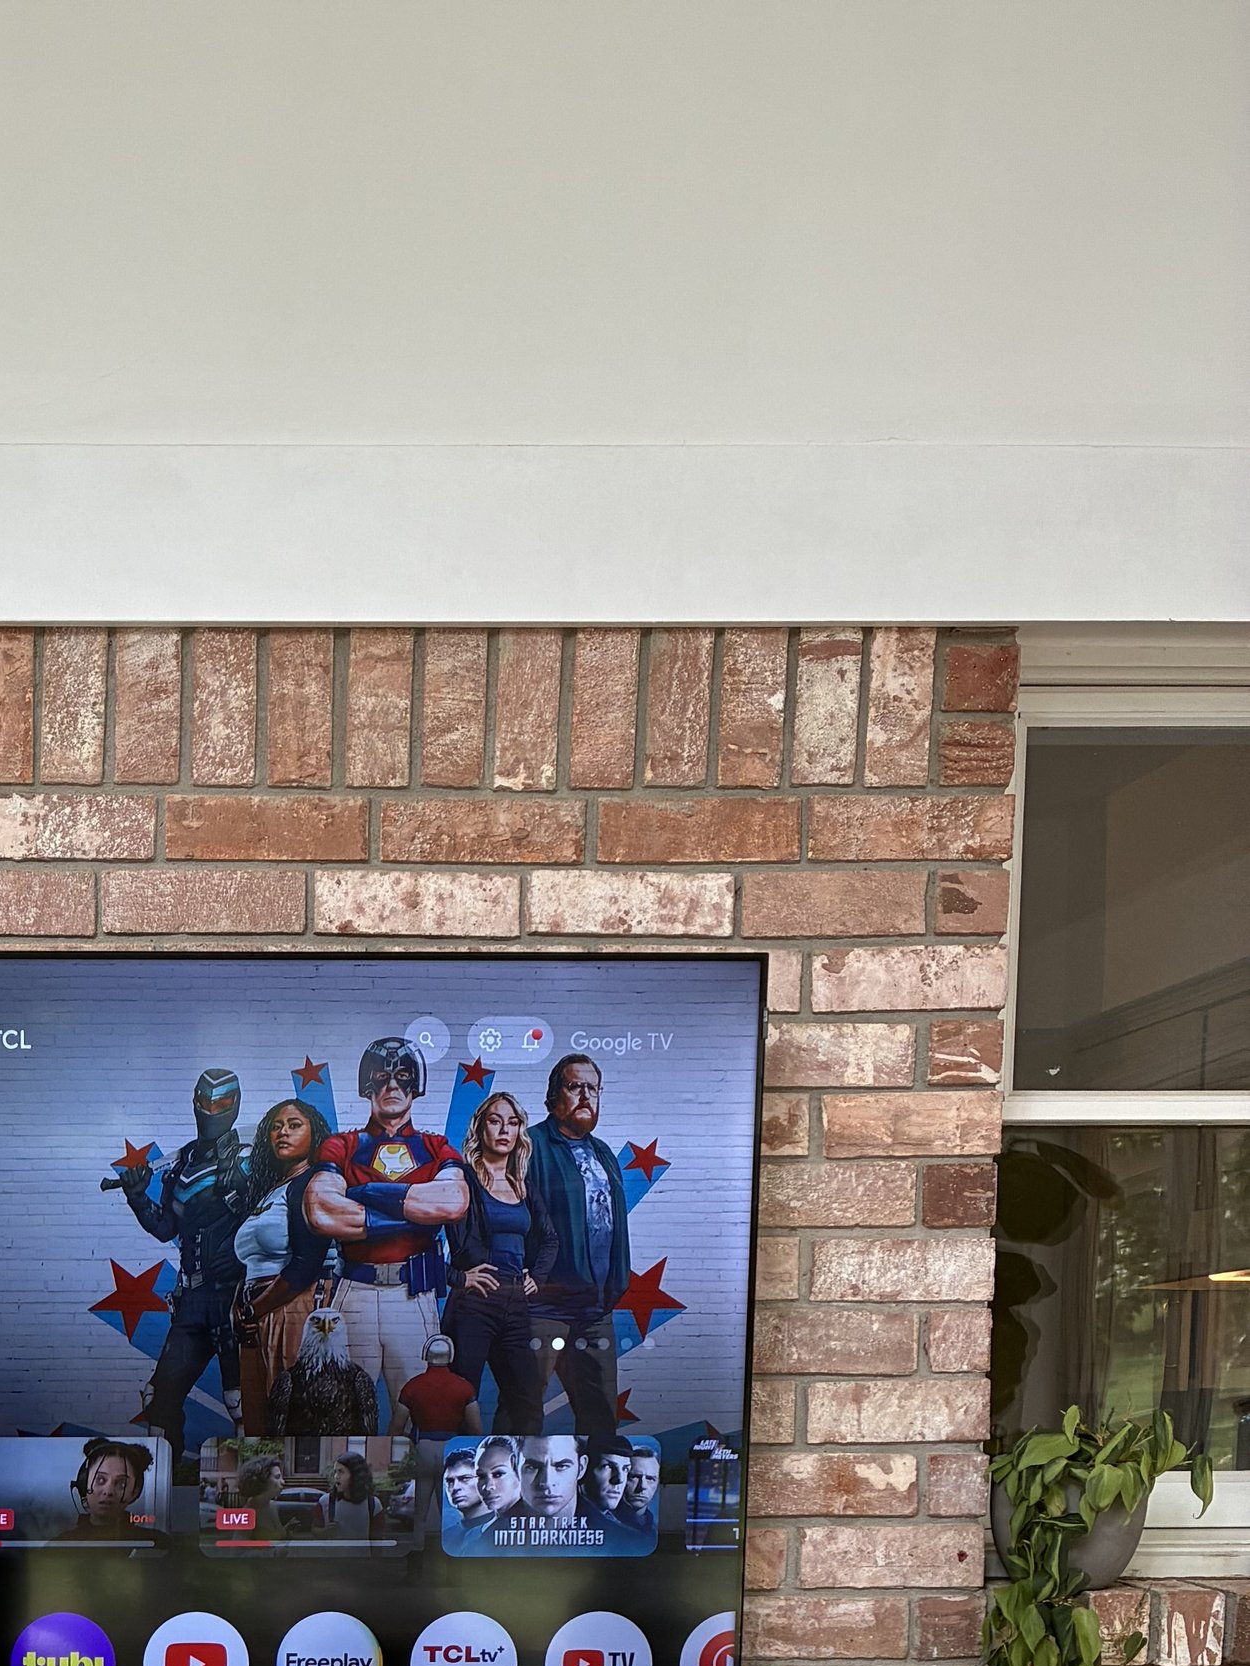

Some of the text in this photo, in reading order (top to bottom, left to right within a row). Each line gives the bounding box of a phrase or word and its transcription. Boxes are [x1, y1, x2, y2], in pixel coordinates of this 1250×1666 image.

[570, 1031, 674, 1055] Google TV
[222, 1513, 249, 1525] LIVE
[510, 1516, 588, 1529] STAR TREK
[494, 1529, 605, 1546] INTO DARKNESS
